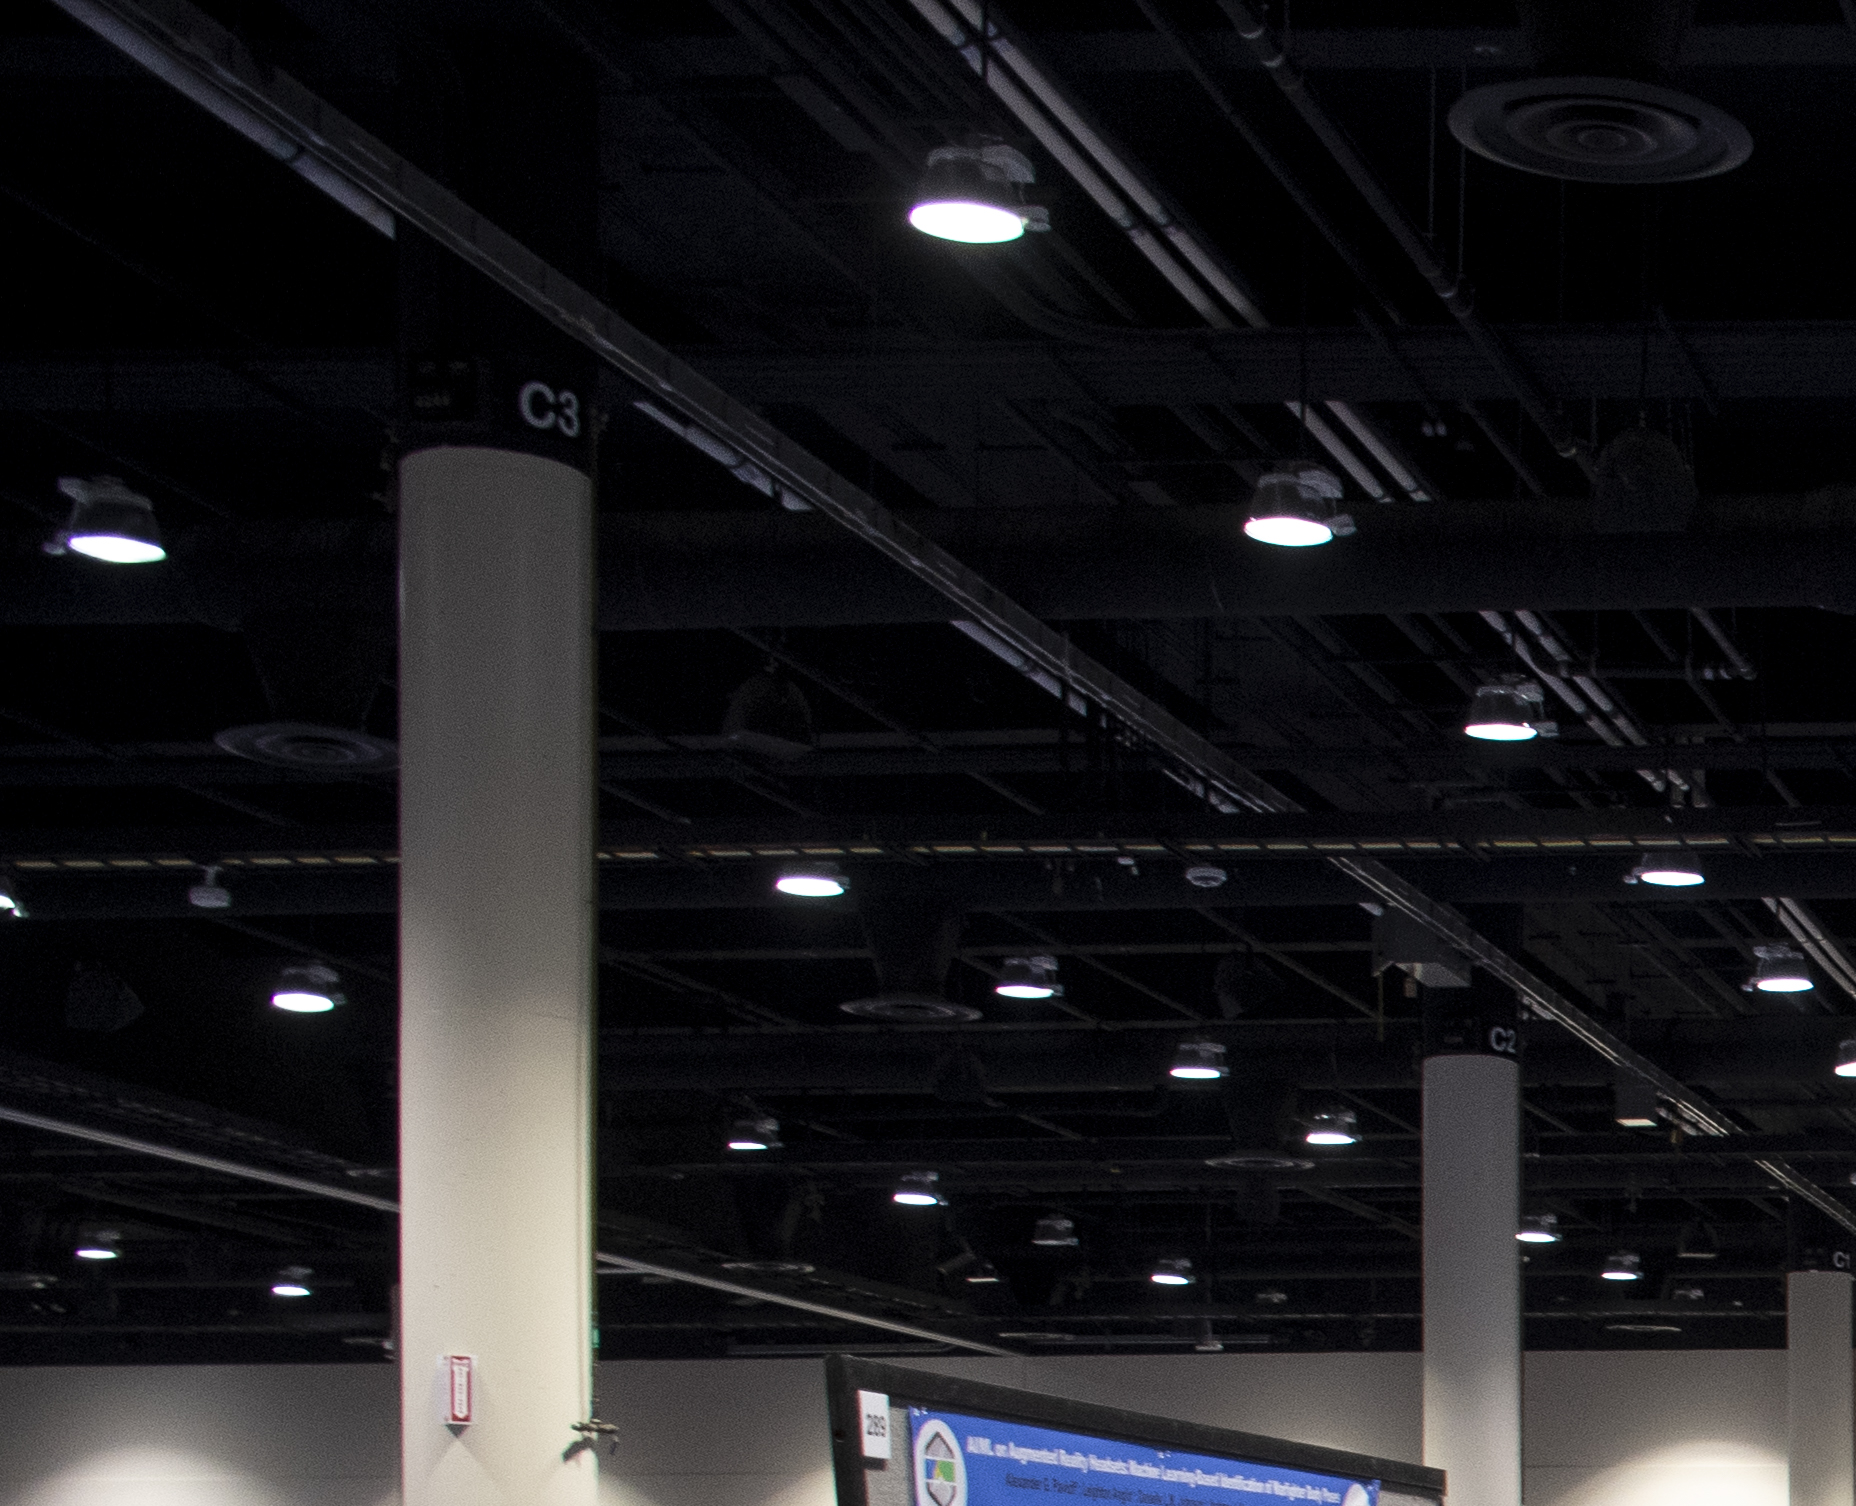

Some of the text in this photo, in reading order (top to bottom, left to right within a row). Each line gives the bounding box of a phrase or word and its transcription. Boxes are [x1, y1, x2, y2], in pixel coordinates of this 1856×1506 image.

[520, 382, 579, 437] C3
[1490, 1027, 1516, 1053] C2
[866, 1414, 887, 1437] 289
